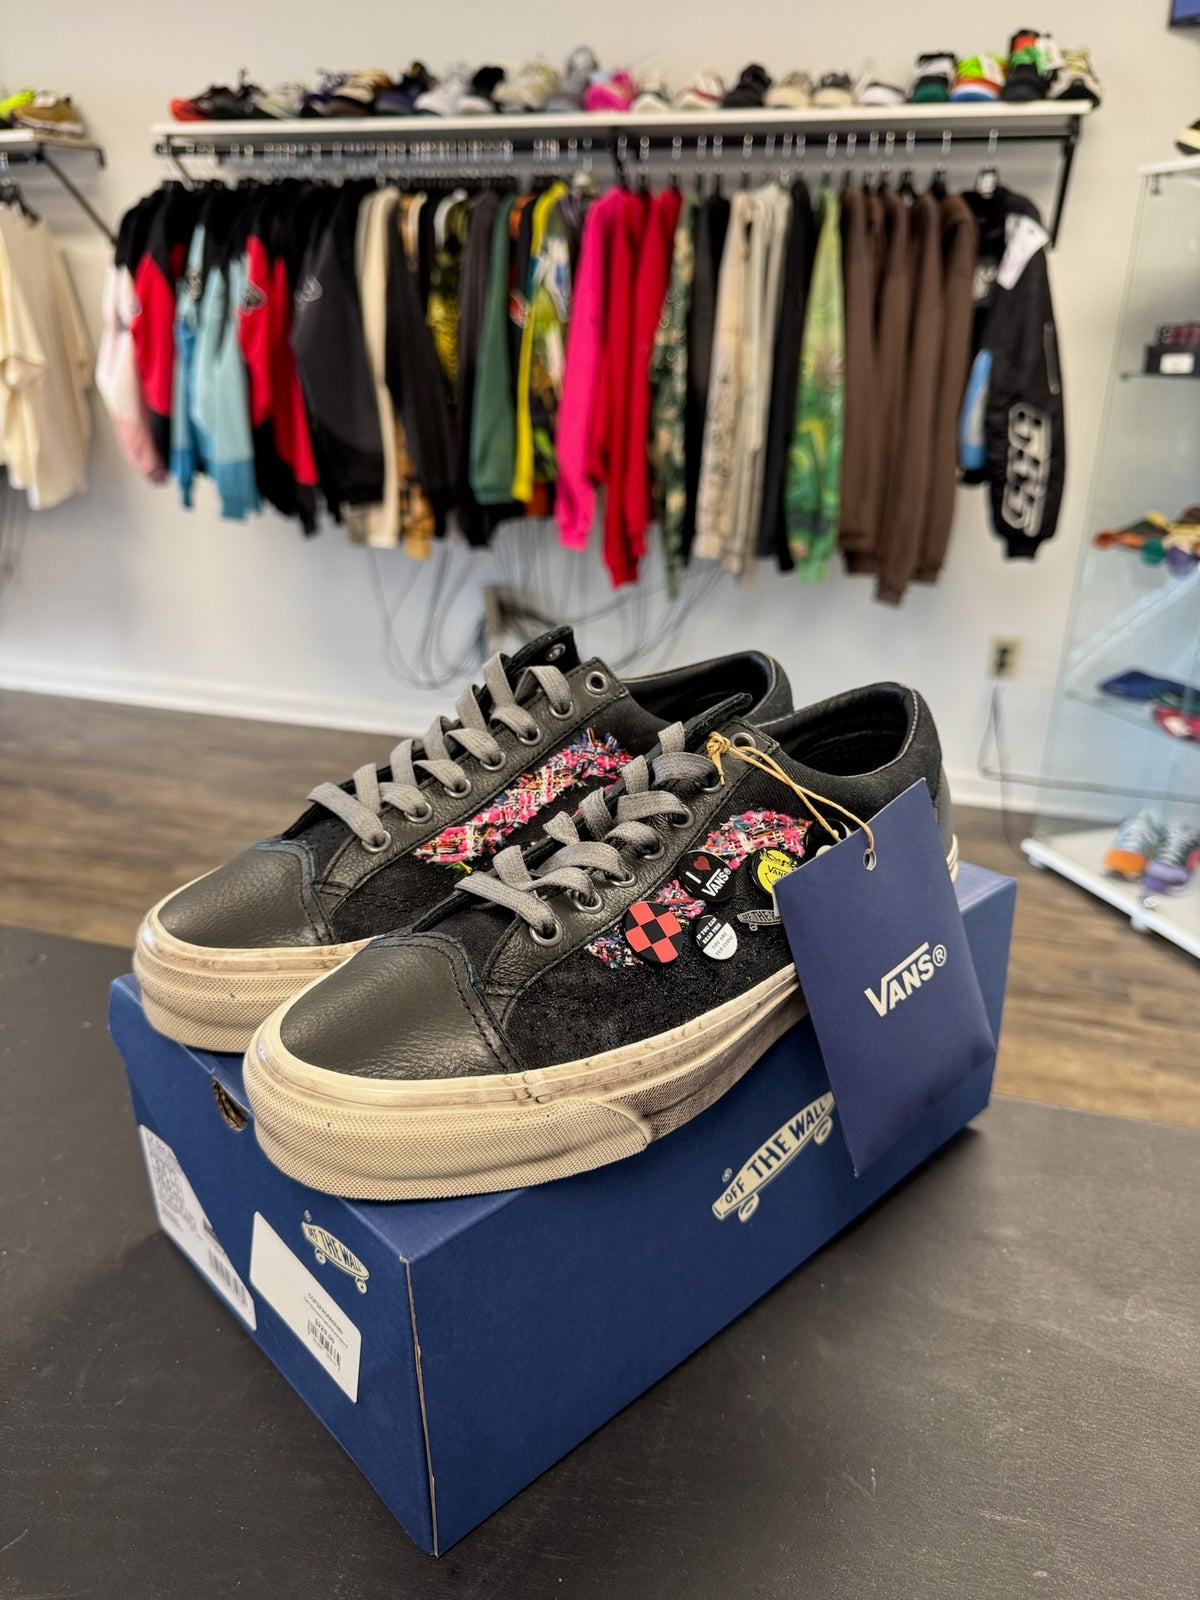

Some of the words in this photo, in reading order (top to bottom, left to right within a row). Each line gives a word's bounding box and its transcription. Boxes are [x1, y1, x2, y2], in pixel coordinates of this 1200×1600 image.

[685, 871, 702, 885] I
[747, 1133, 791, 1178] THE
[318, 1230, 342, 1262] THE
